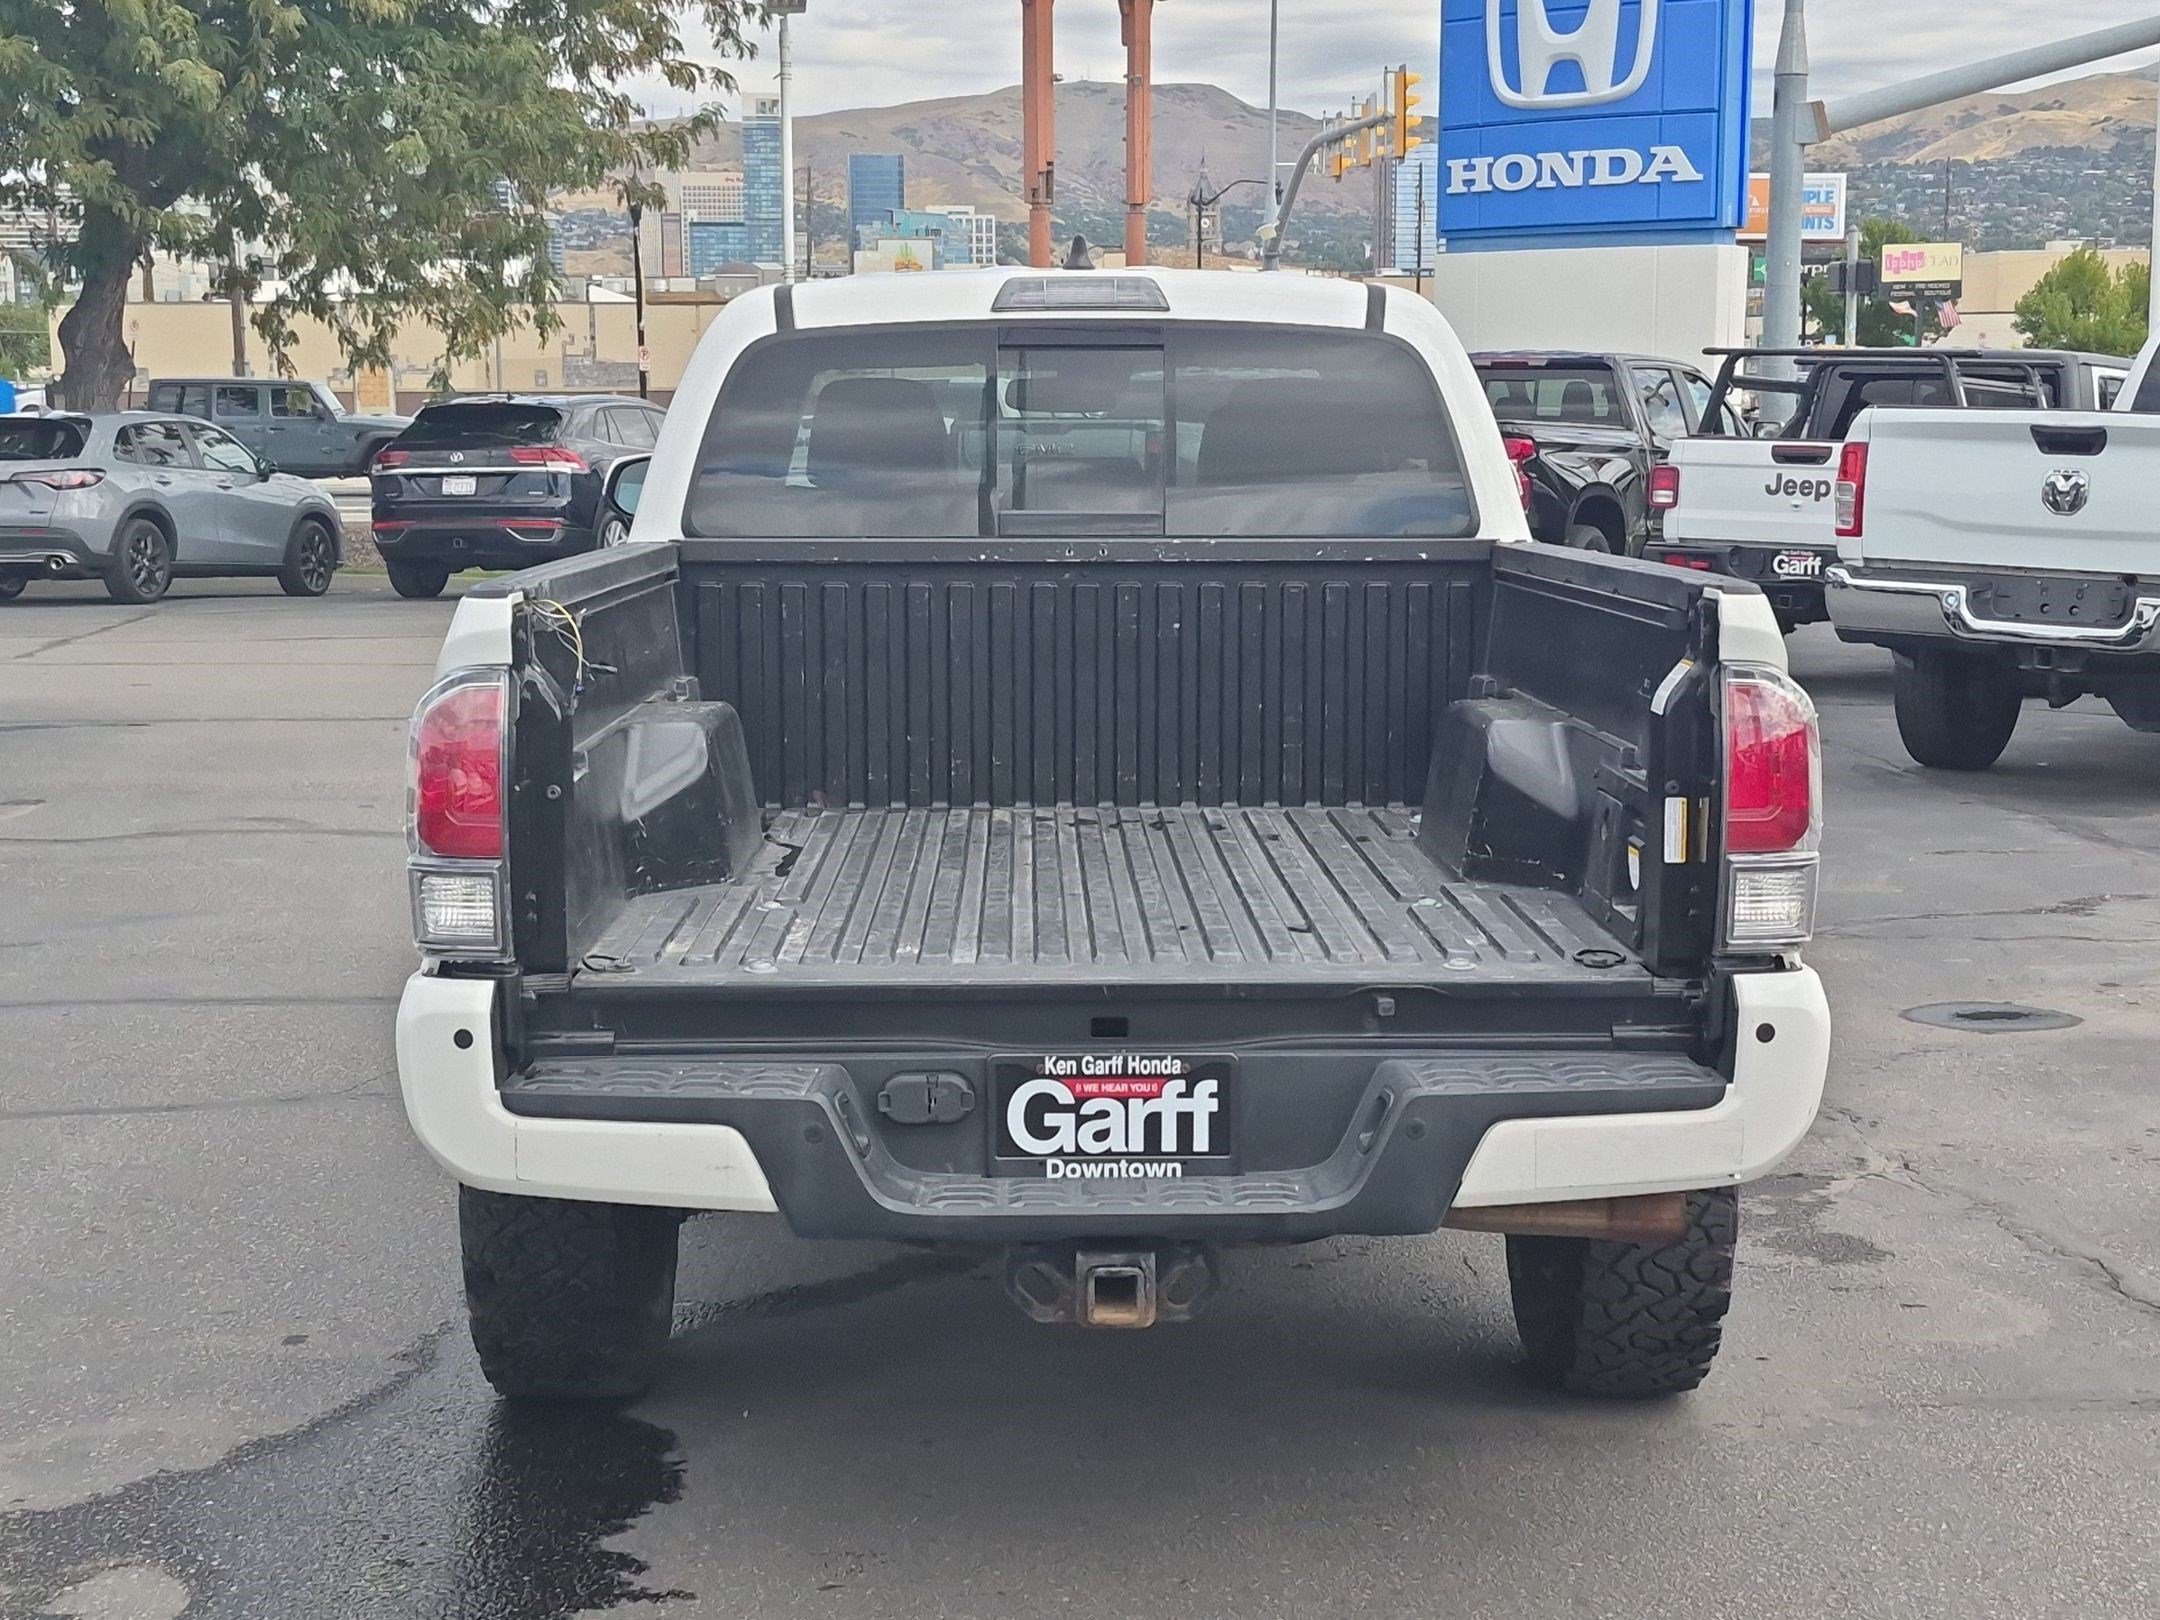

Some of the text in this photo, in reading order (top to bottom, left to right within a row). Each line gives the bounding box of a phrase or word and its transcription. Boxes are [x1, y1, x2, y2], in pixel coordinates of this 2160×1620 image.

[1446, 146, 1704, 194] HONDA
[1765, 472, 1832, 502] Jeep
[1773, 555, 1822, 576] Garff
[1044, 1055, 1182, 1076] Ken Garff Honda
[1083, 1083, 1151, 1093] WE HEAR YOU
[1007, 1078, 1219, 1155] Garff
[1046, 1159, 1182, 1179] Downtown
